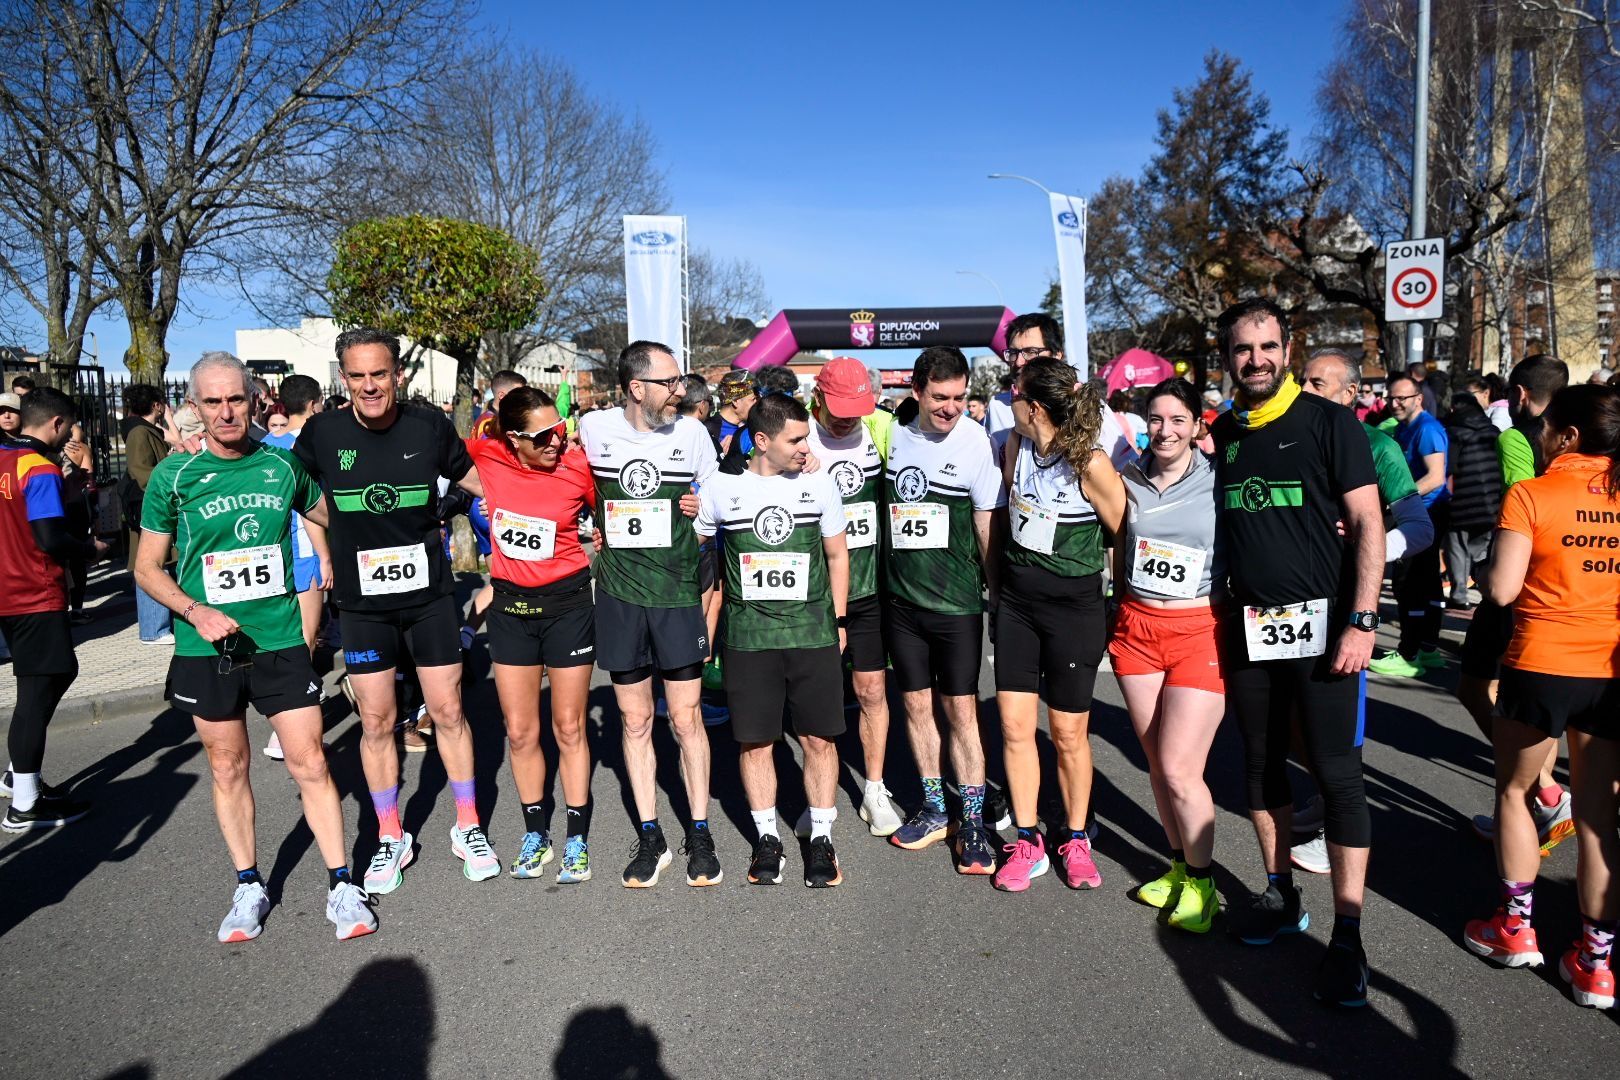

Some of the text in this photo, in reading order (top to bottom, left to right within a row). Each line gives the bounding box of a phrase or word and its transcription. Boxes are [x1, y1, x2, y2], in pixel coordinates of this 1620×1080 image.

[1390, 243, 1440, 259] ZONA
[1402, 281, 1426, 295] 30
[880, 320, 940, 331] DIPUTACIÓN
[880, 331, 921, 341] DE LEÓN
[238, 492, 284, 511] CORRE
[628, 517, 642, 536] 8
[901, 520, 928, 537] 45
[1019, 513, 1029, 532] 7
[501, 529, 541, 550] 426
[218, 564, 271, 590] 315
[372, 563, 416, 582] 450
[753, 570, 796, 588] 166
[1142, 558, 1186, 583] 493
[1261, 621, 1313, 645] 334
